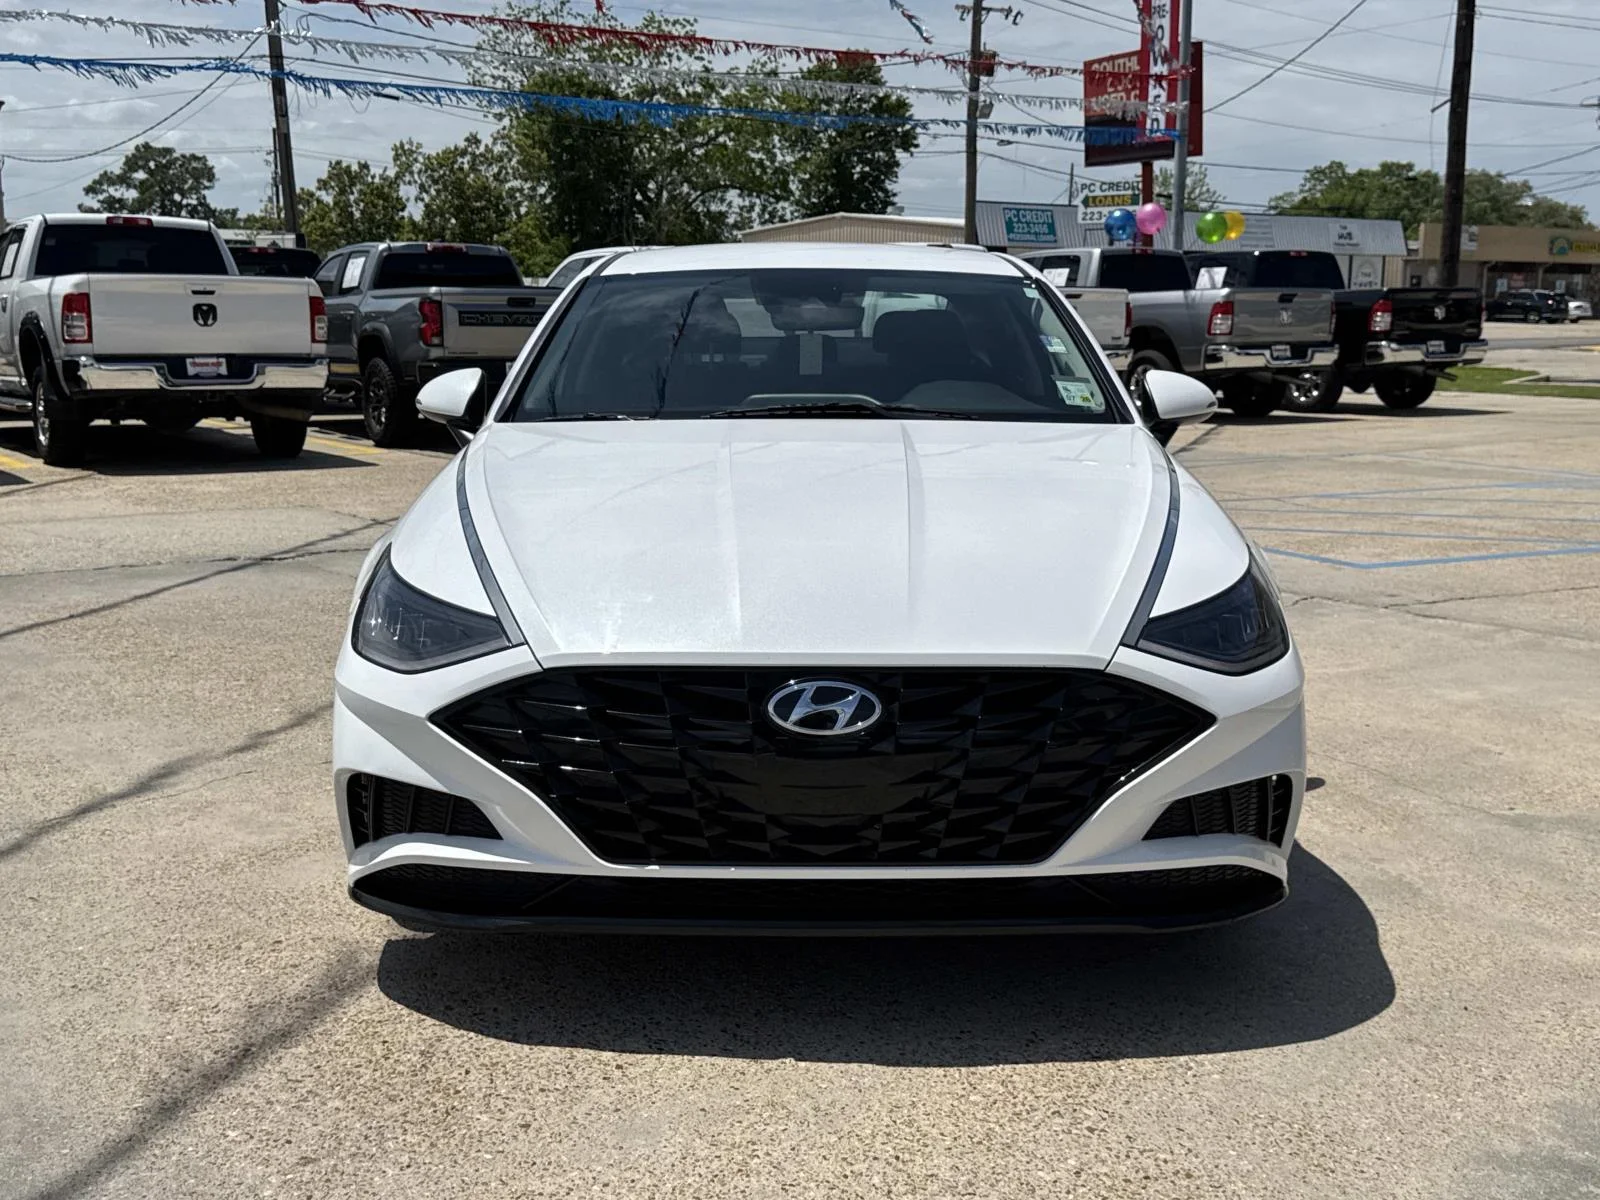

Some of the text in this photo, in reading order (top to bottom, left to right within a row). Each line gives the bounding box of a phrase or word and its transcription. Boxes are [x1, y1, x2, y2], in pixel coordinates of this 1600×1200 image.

[1080, 181, 1141, 193] PC CREDIT
[1088, 195, 1132, 208] LOANS
[1005, 209, 1053, 223] PC CREDIT
